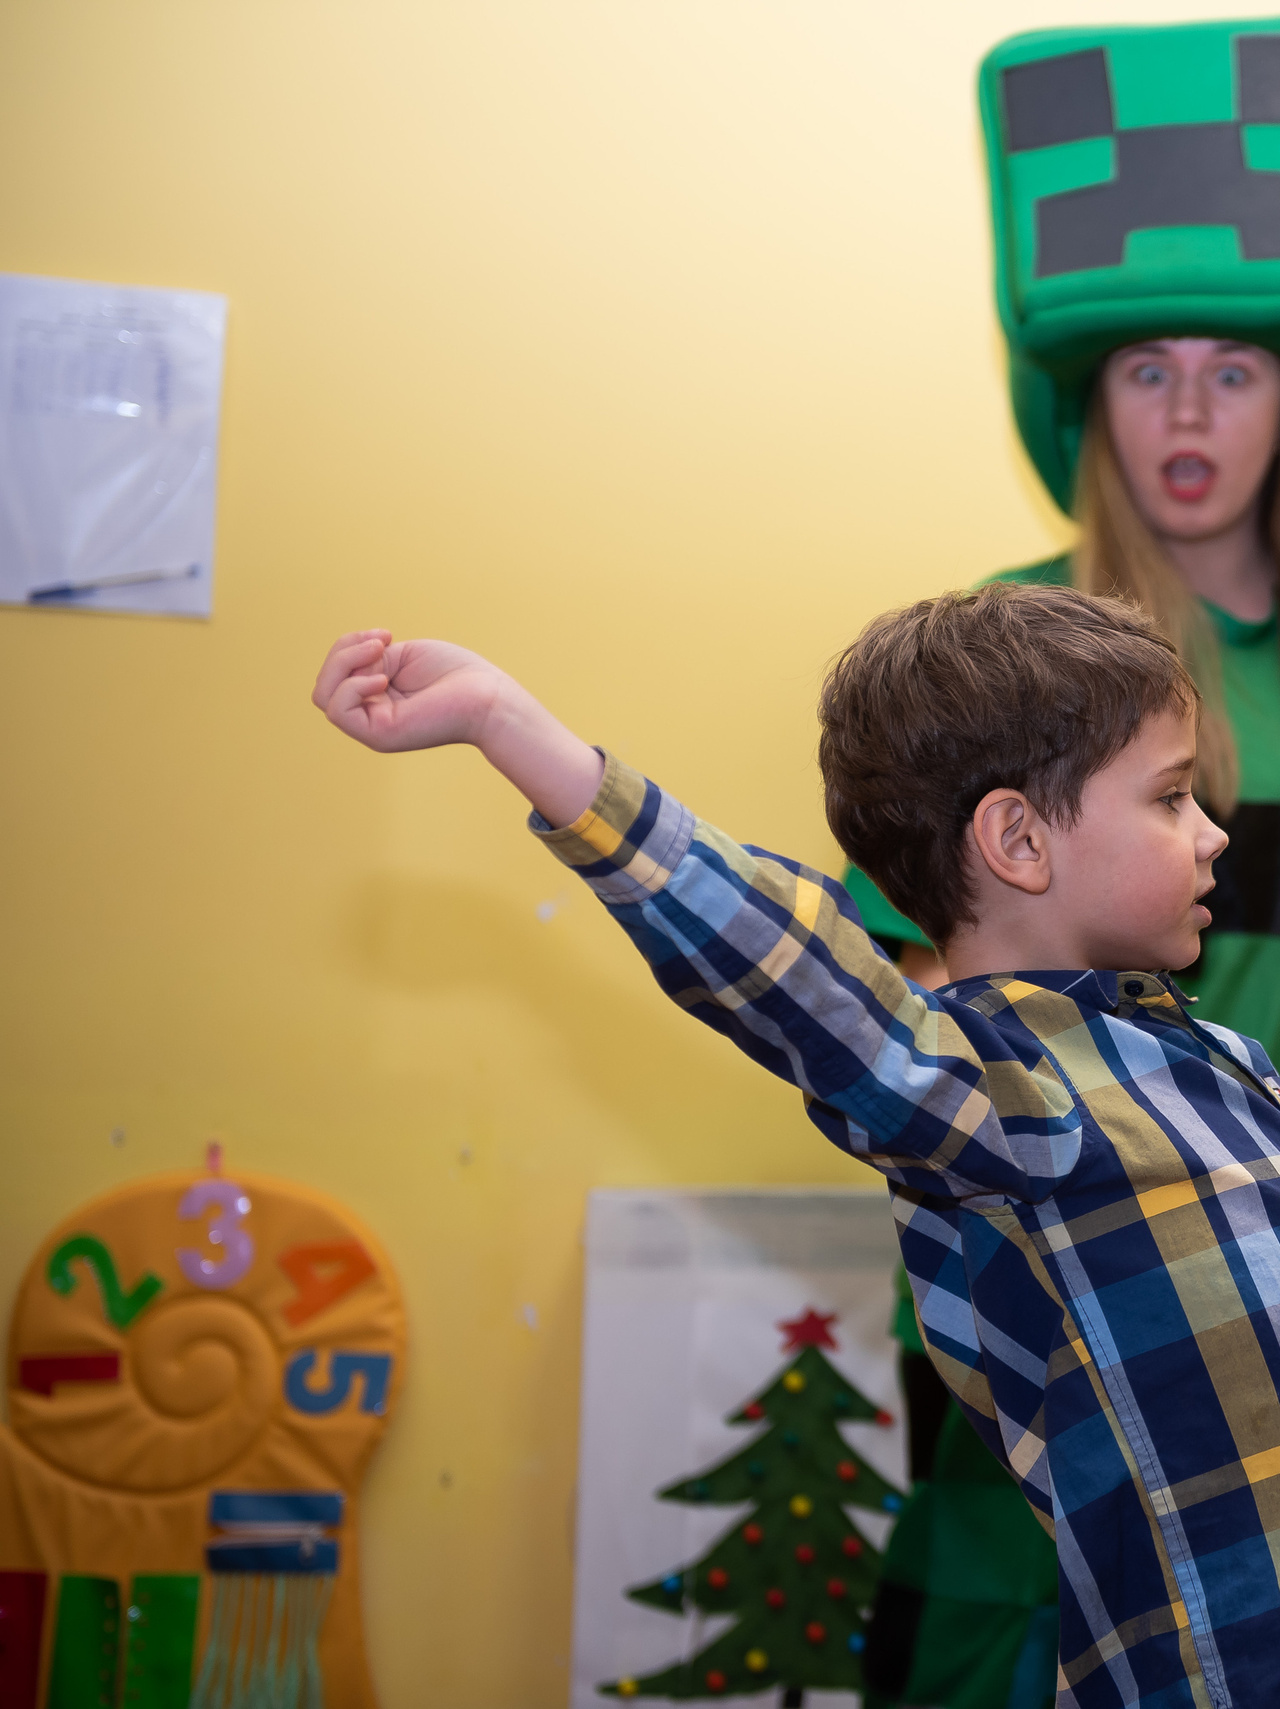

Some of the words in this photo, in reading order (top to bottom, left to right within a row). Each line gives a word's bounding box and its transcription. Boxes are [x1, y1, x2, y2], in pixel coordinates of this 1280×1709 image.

[176, 1178, 255, 1290] 3
[47, 1233, 164, 1330] 2
[278, 1237, 377, 1327] 4
[20, 1351, 119, 1398] 1
[284, 1347, 393, 1416] 5
